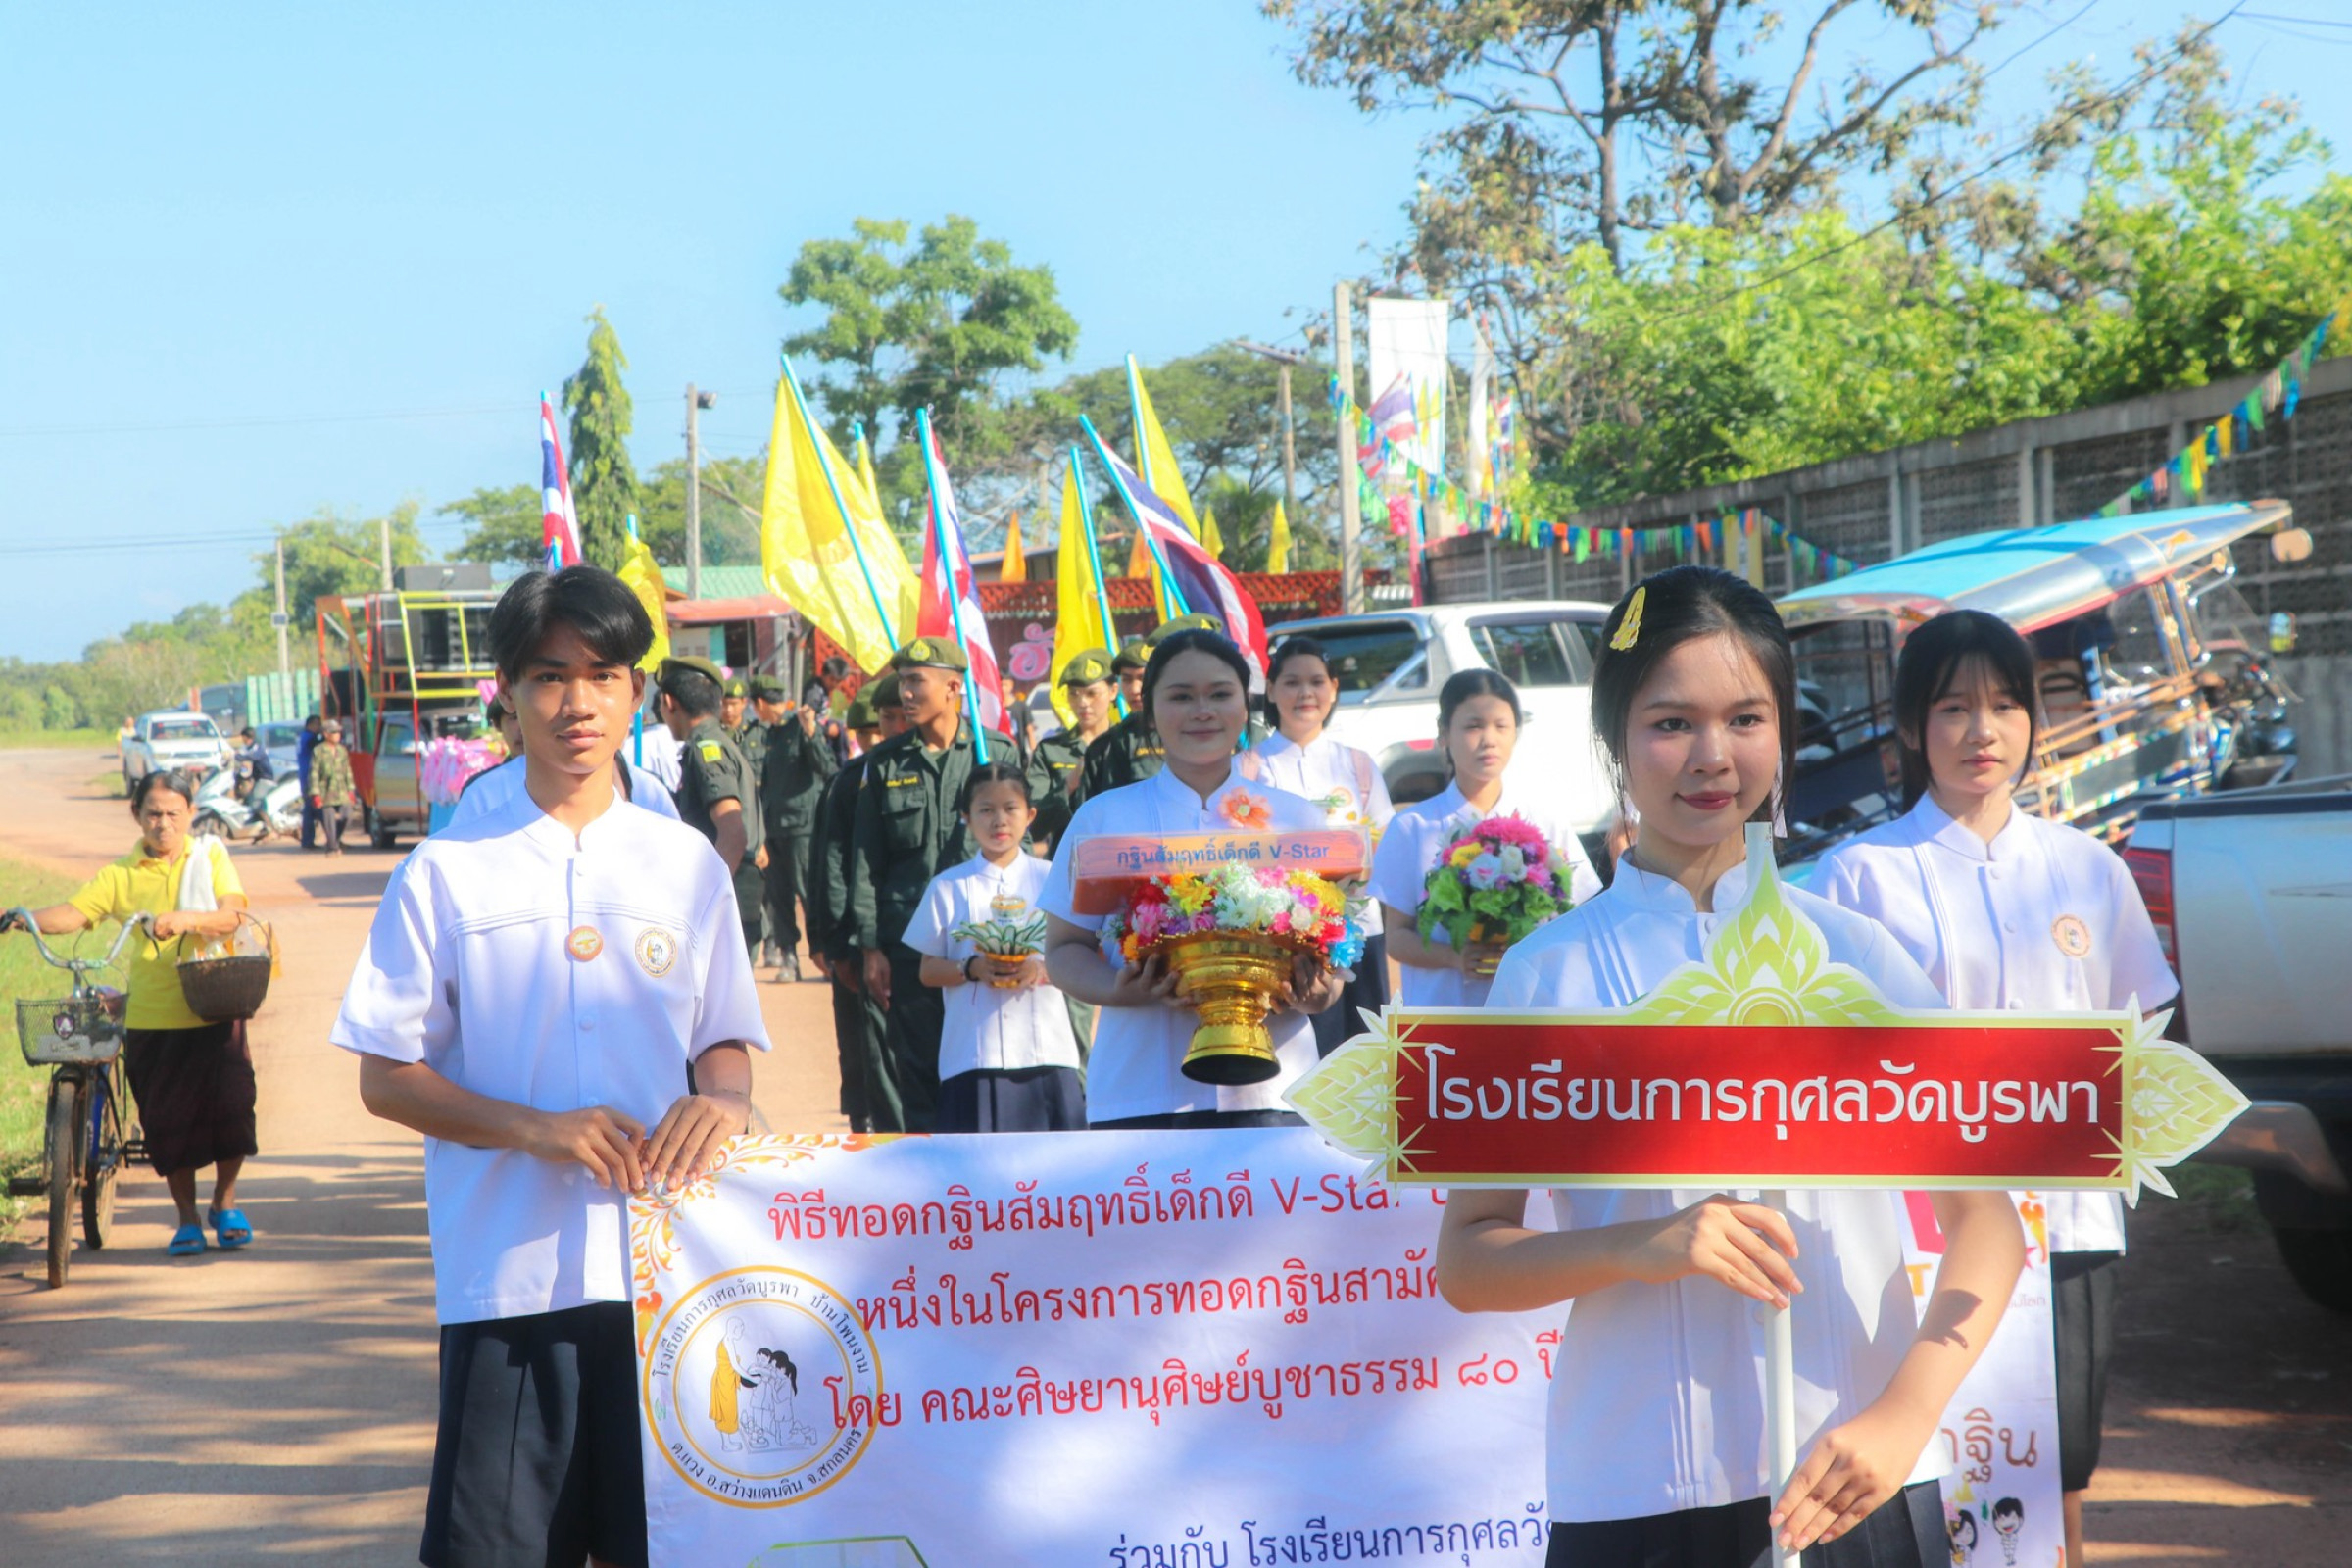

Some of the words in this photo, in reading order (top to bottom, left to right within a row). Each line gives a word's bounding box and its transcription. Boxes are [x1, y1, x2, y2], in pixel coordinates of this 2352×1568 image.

[1269, 843, 1330, 859] V-Star
[1424, 1042, 2099, 1144] โรงเรียนการกุศลวัดบูรพา
[766, 1162, 1254, 1250] พิธีทอดกฐินสัมฤทธิ์เด็กดี
[1271, 1173, 1401, 1215] V-Sta
[651, 1277, 800, 1378] โรงเรียนการกุศลวัดบูรพา
[823, 1375, 902, 1431] โดย
[922, 1348, 1439, 1427] คณะศิษยานุศิษย์บูชาธรรม
[1457, 1352, 1520, 1388] ๘๐
[1109, 1525, 1229, 1568] ร่วมกับ
[1241, 1500, 1553, 1568] โรงเรียนการกุศลวั
